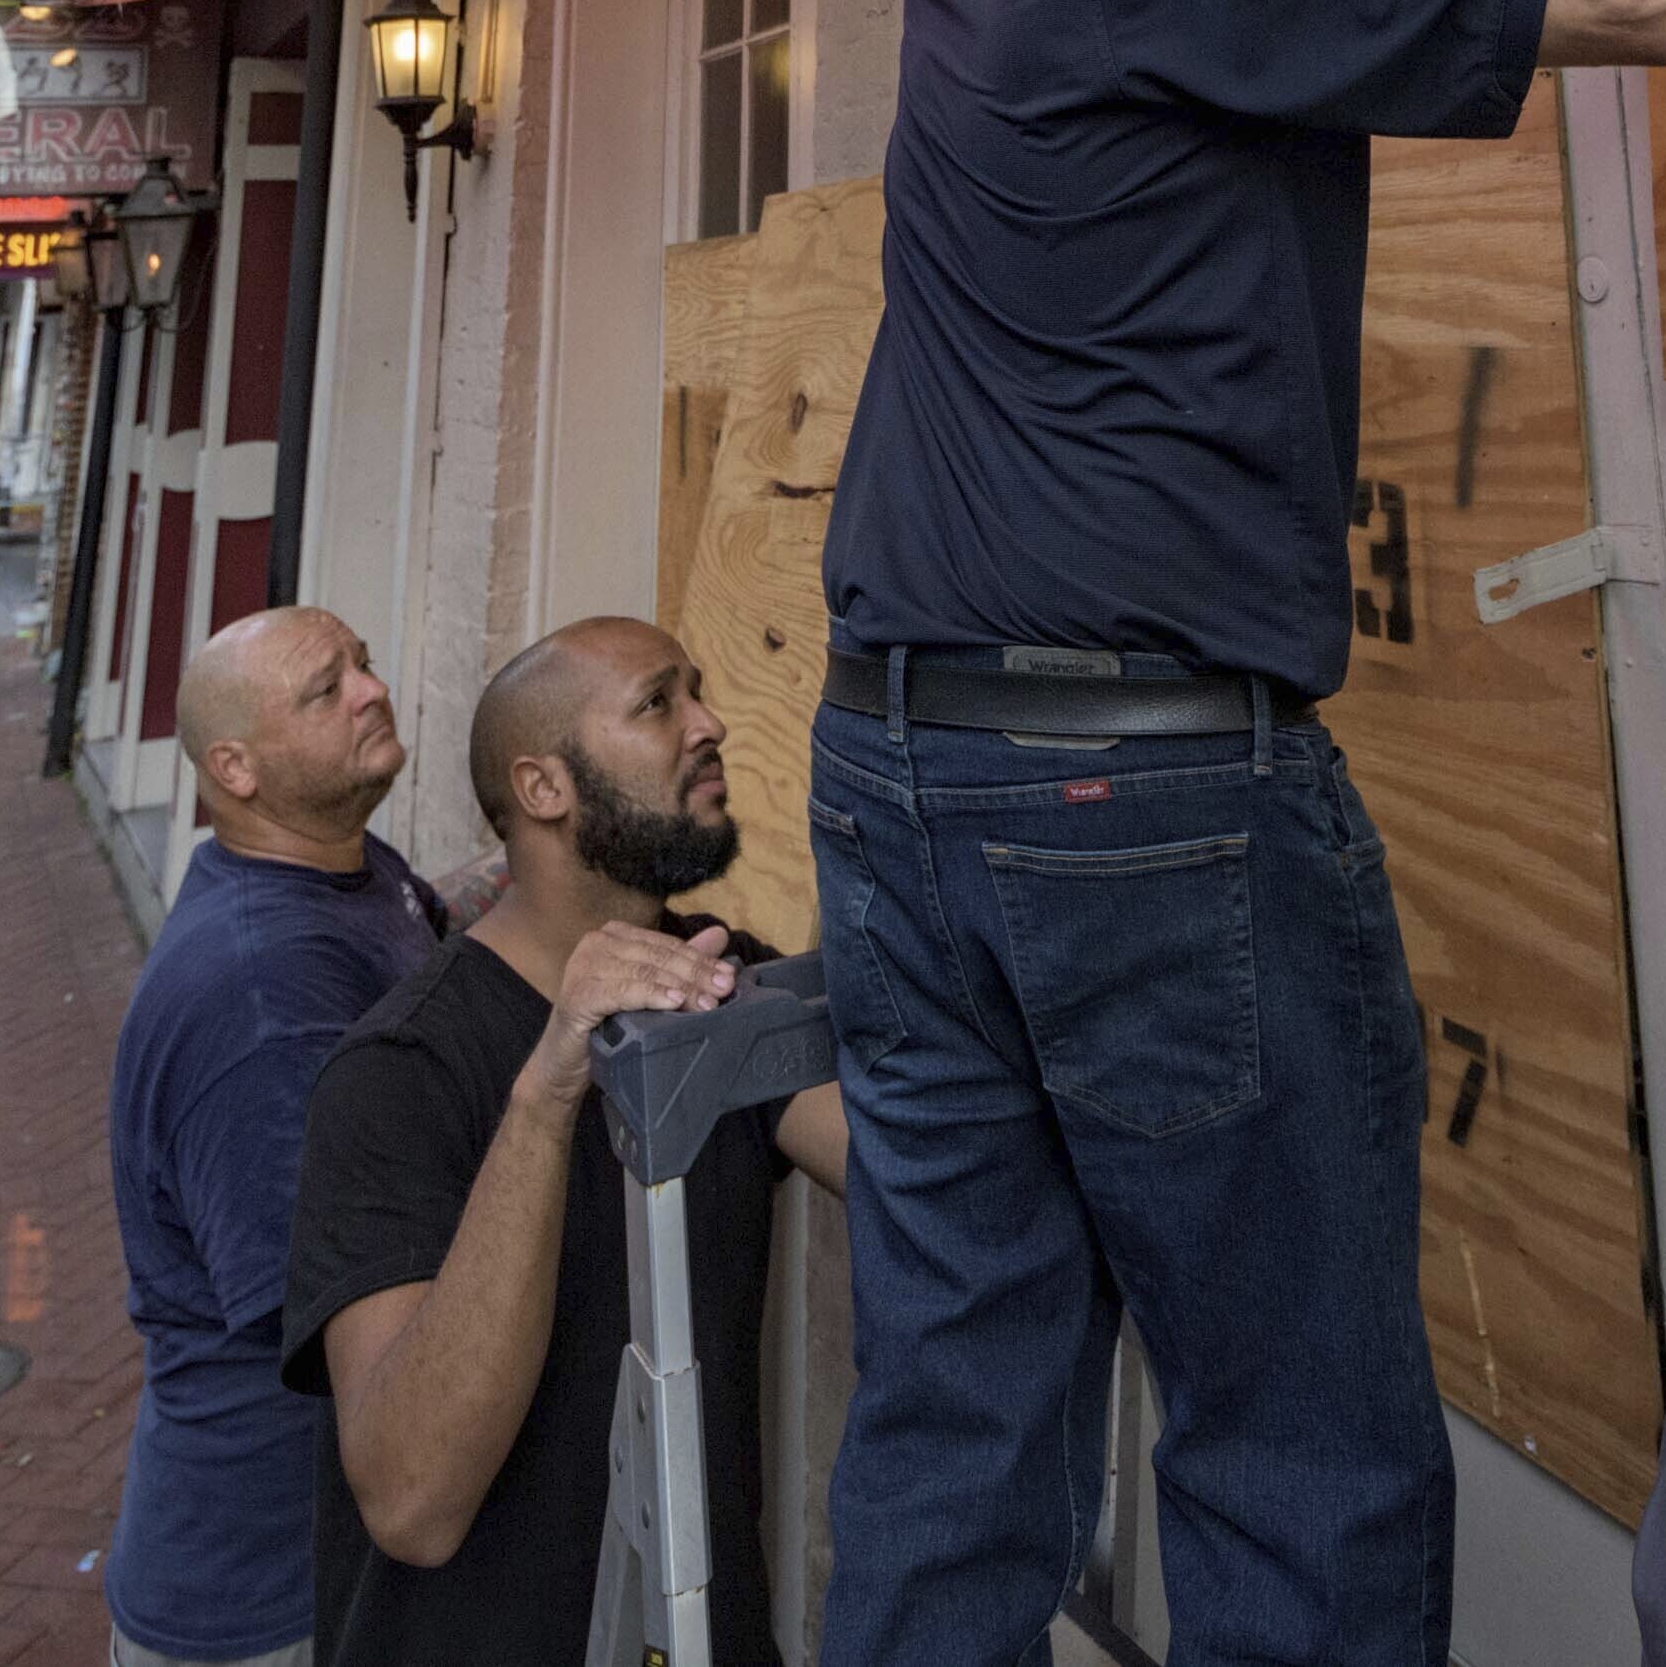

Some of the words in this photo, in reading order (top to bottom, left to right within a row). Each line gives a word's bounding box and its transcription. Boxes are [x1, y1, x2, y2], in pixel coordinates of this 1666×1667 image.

[105, 164, 148, 183] COM
[7, 232, 68, 268] SLI
[1028, 659, 1096, 675] Wrangler
